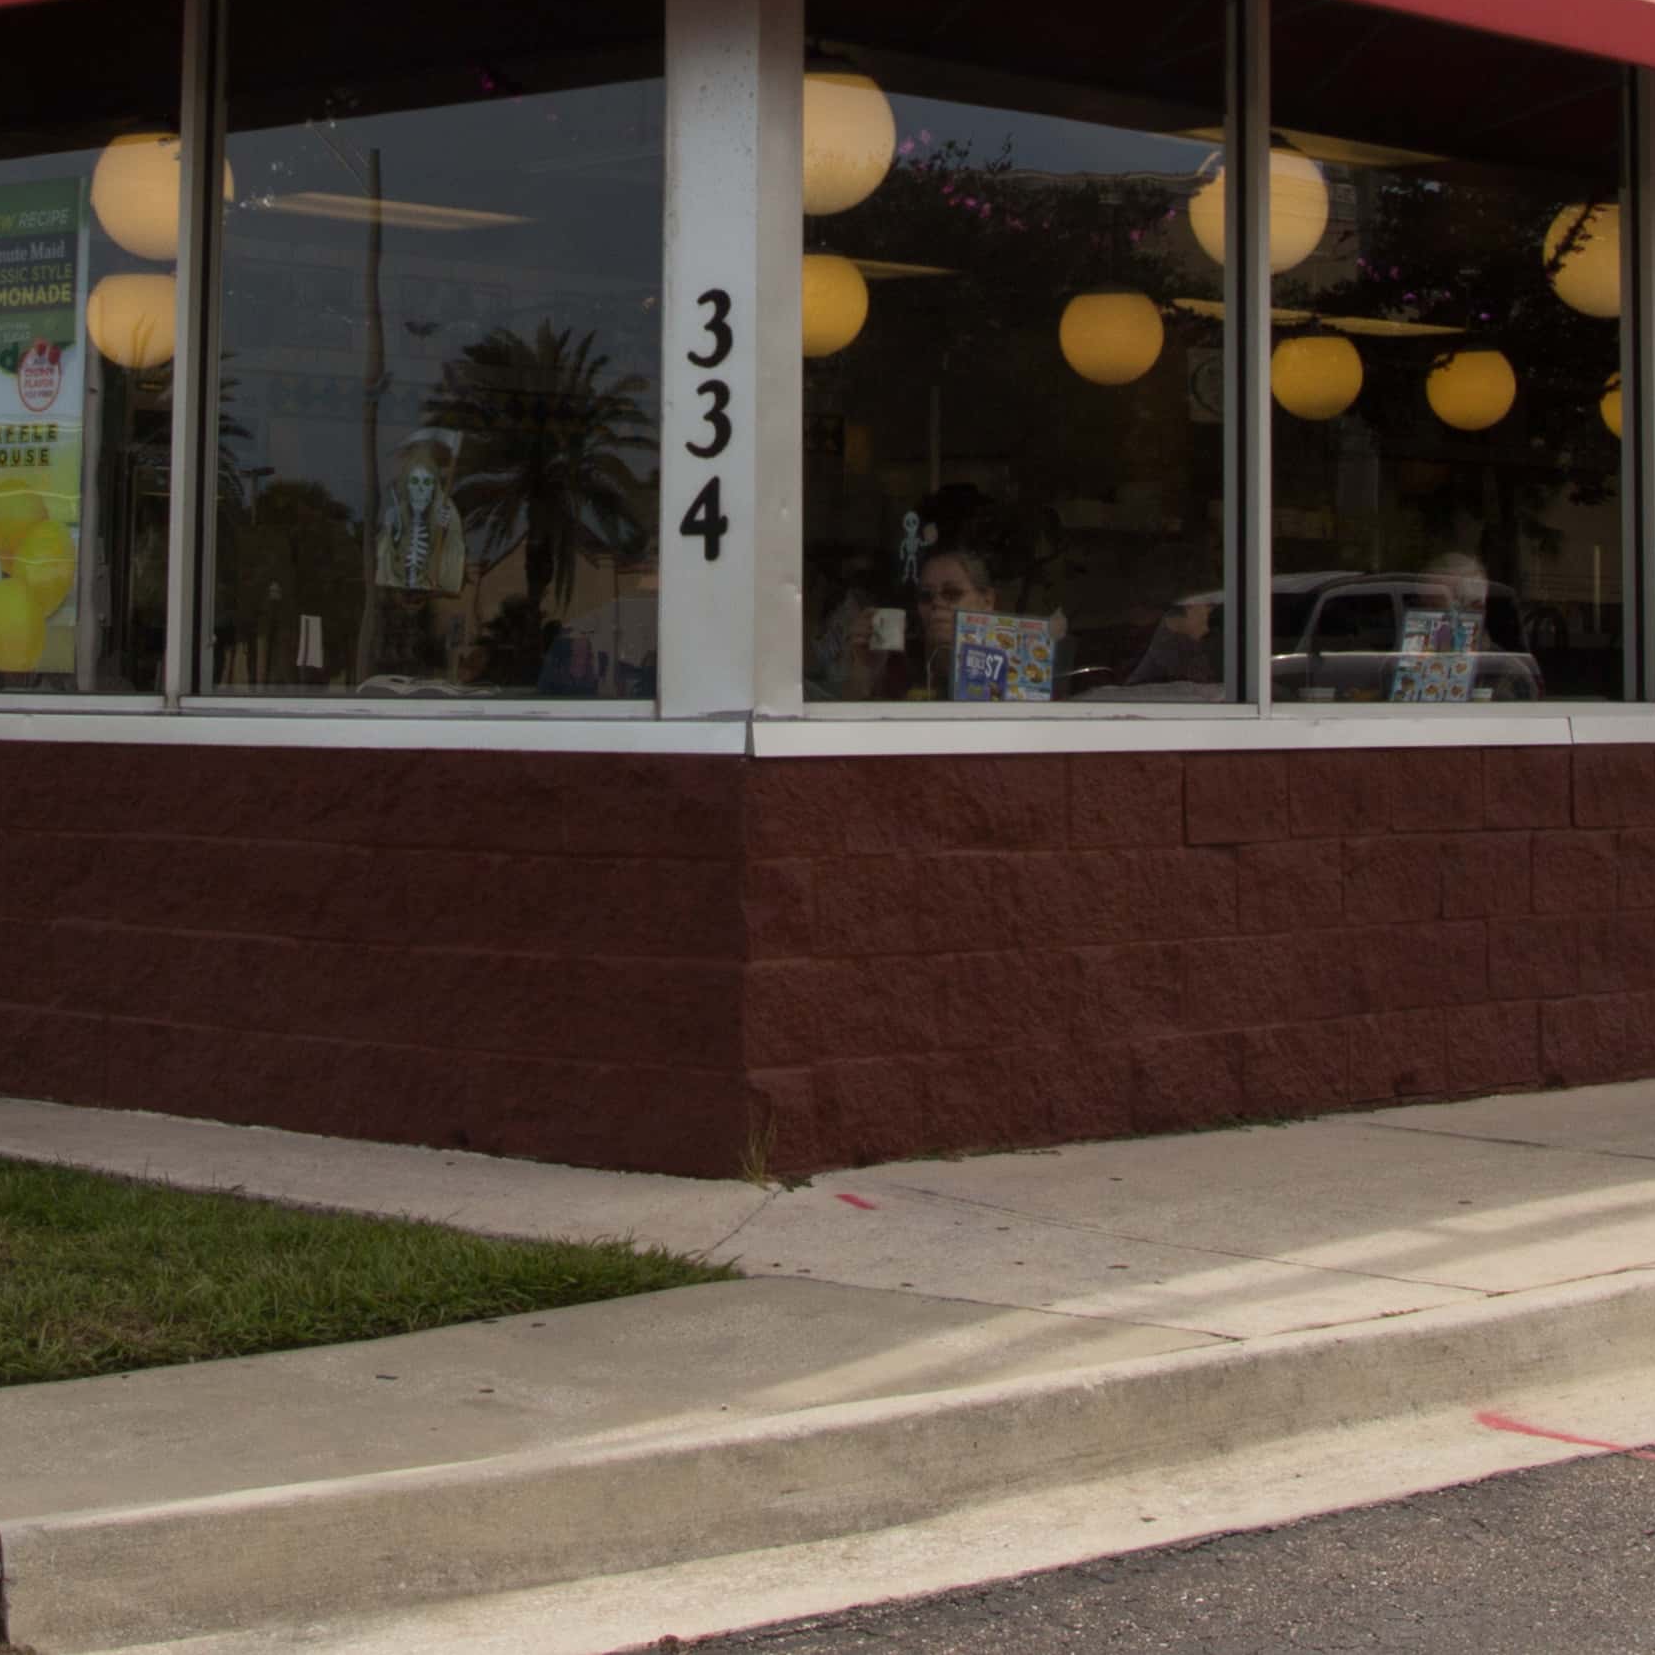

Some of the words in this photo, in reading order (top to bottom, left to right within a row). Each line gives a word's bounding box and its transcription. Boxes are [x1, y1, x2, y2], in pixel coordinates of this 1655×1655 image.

[18, 208, 71, 227] RECIPE
[30, 239, 66, 260] Maid
[31, 263, 72, 283] STYLE
[679, 289, 733, 561] 334
